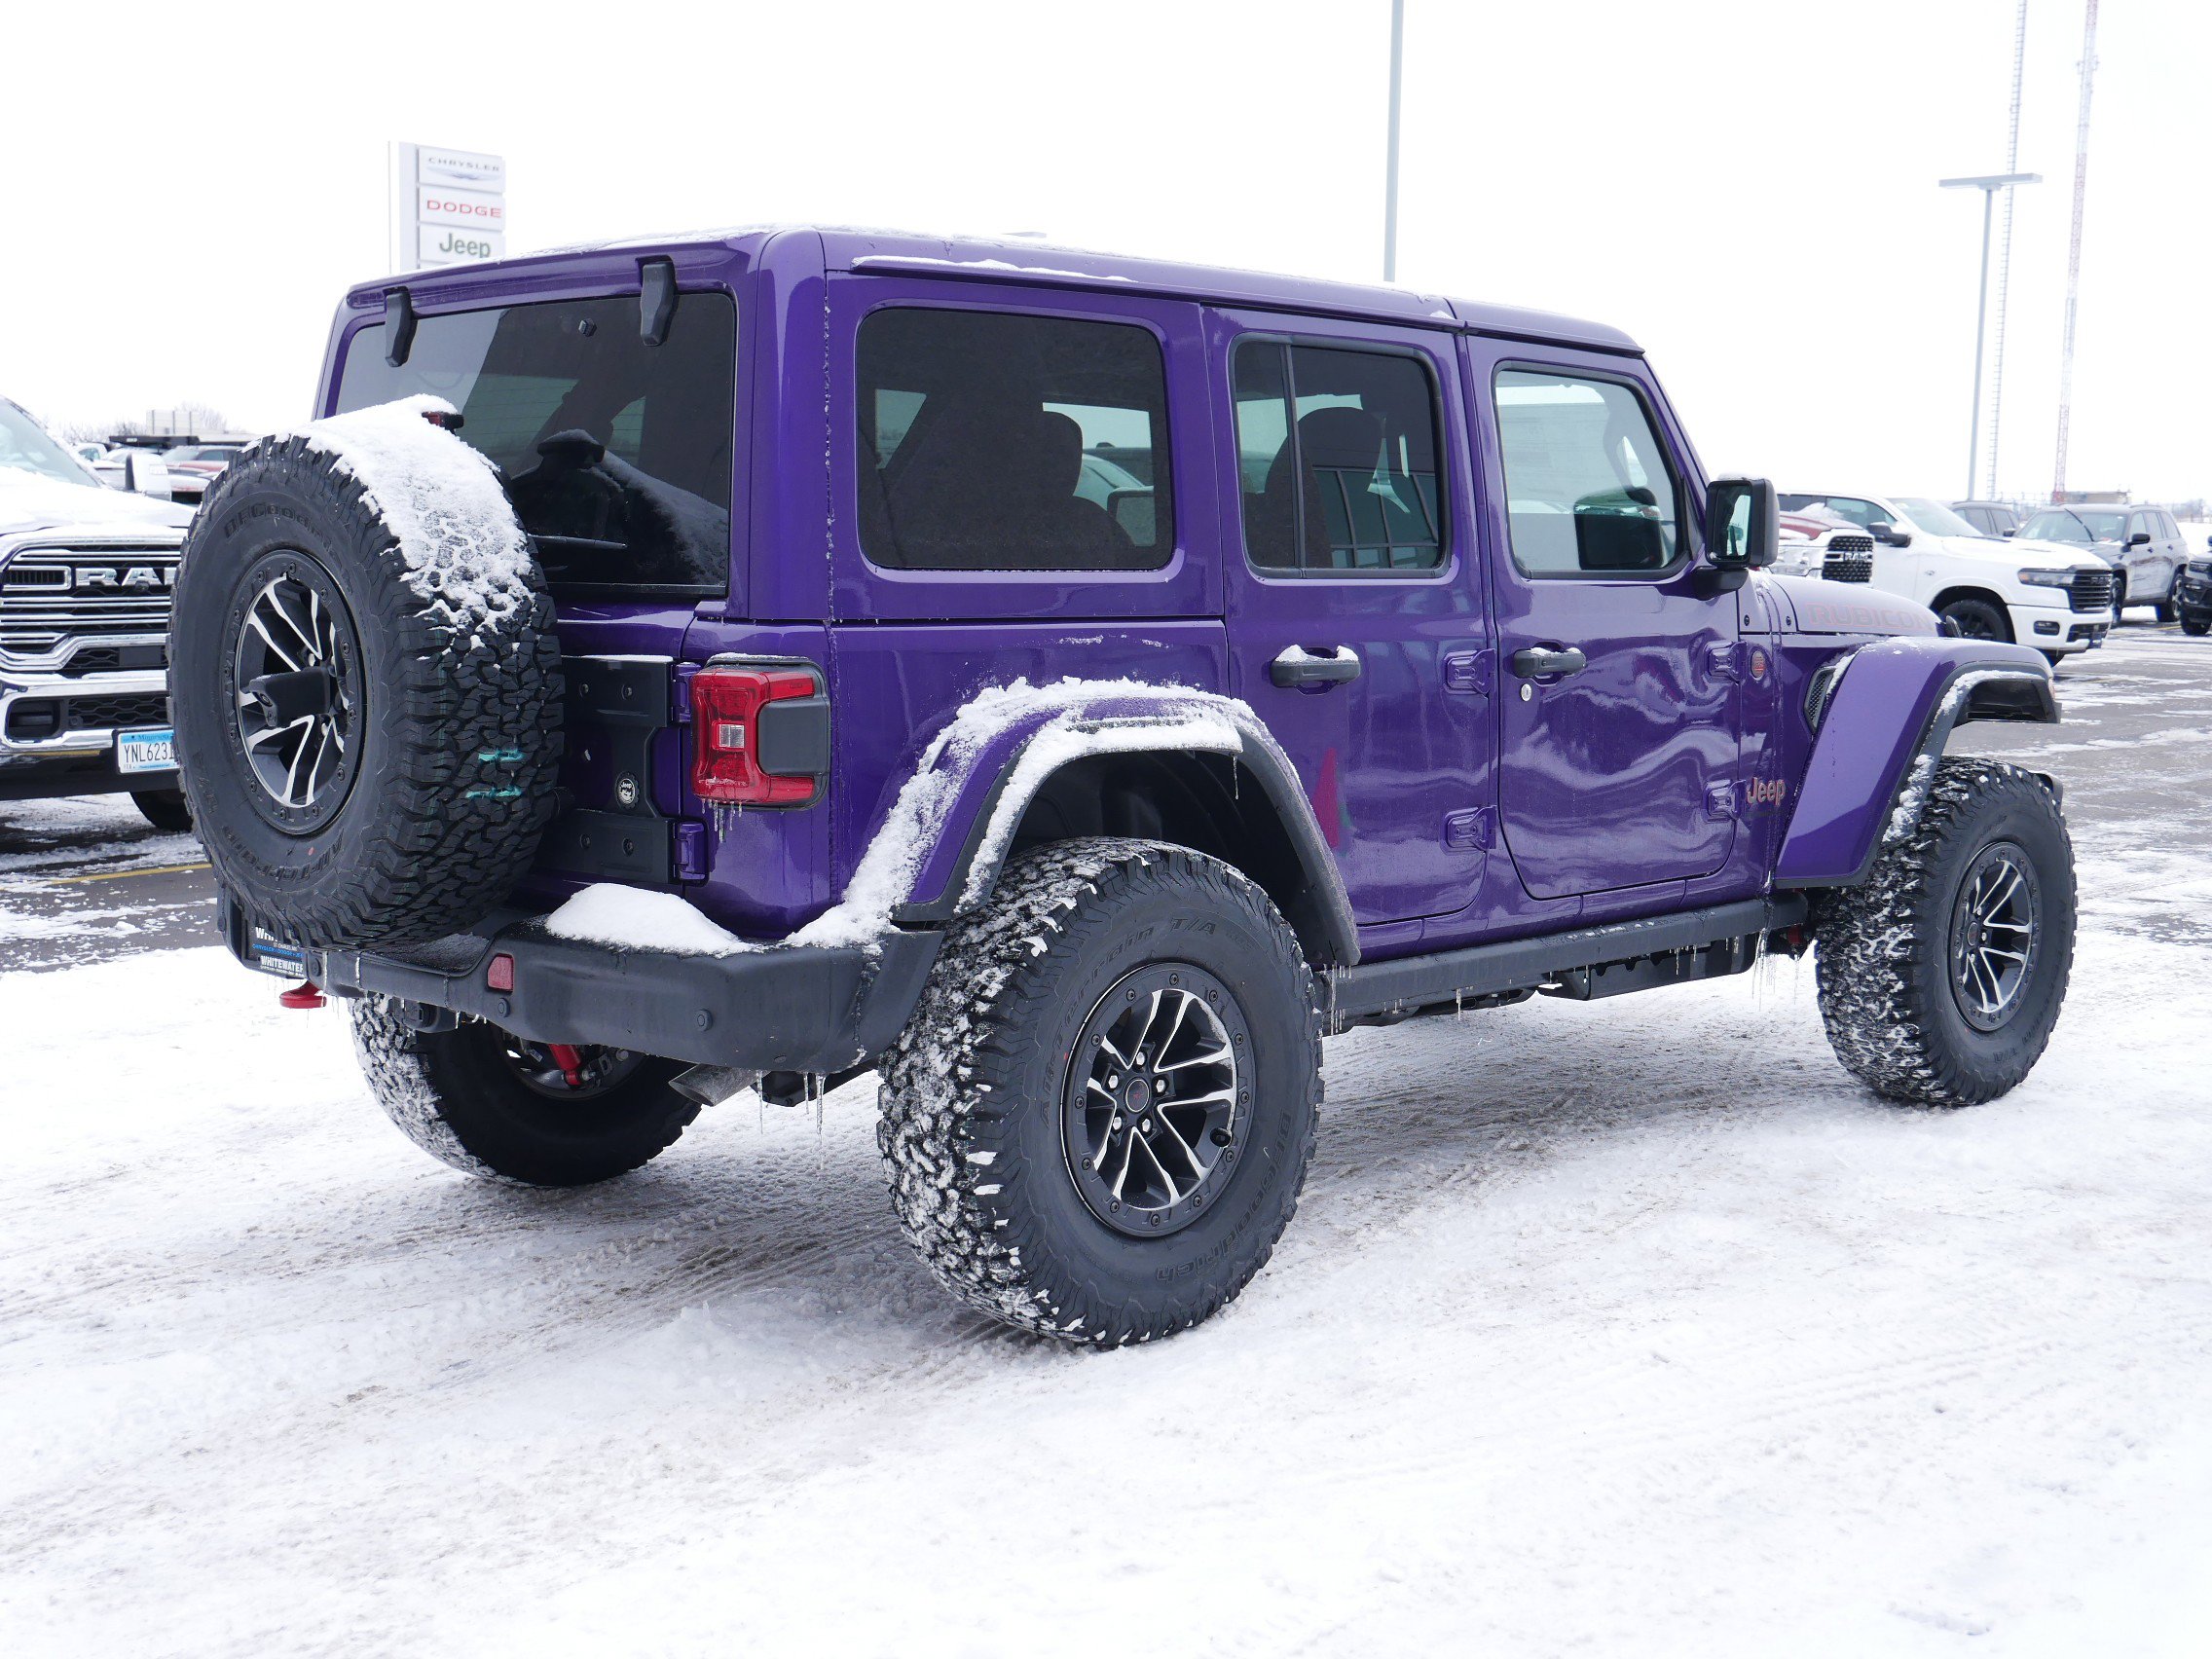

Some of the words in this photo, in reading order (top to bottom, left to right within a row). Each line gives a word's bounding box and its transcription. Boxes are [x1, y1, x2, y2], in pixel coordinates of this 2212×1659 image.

[428, 157, 499, 171] CHRYSLER
[426, 200, 502, 218] DODGE
[439, 233, 491, 258] Jeep
[1805, 602, 1934, 631] RUBICON
[1747, 777, 1786, 807] Jeep
[1170, 917, 1217, 936] T/A
